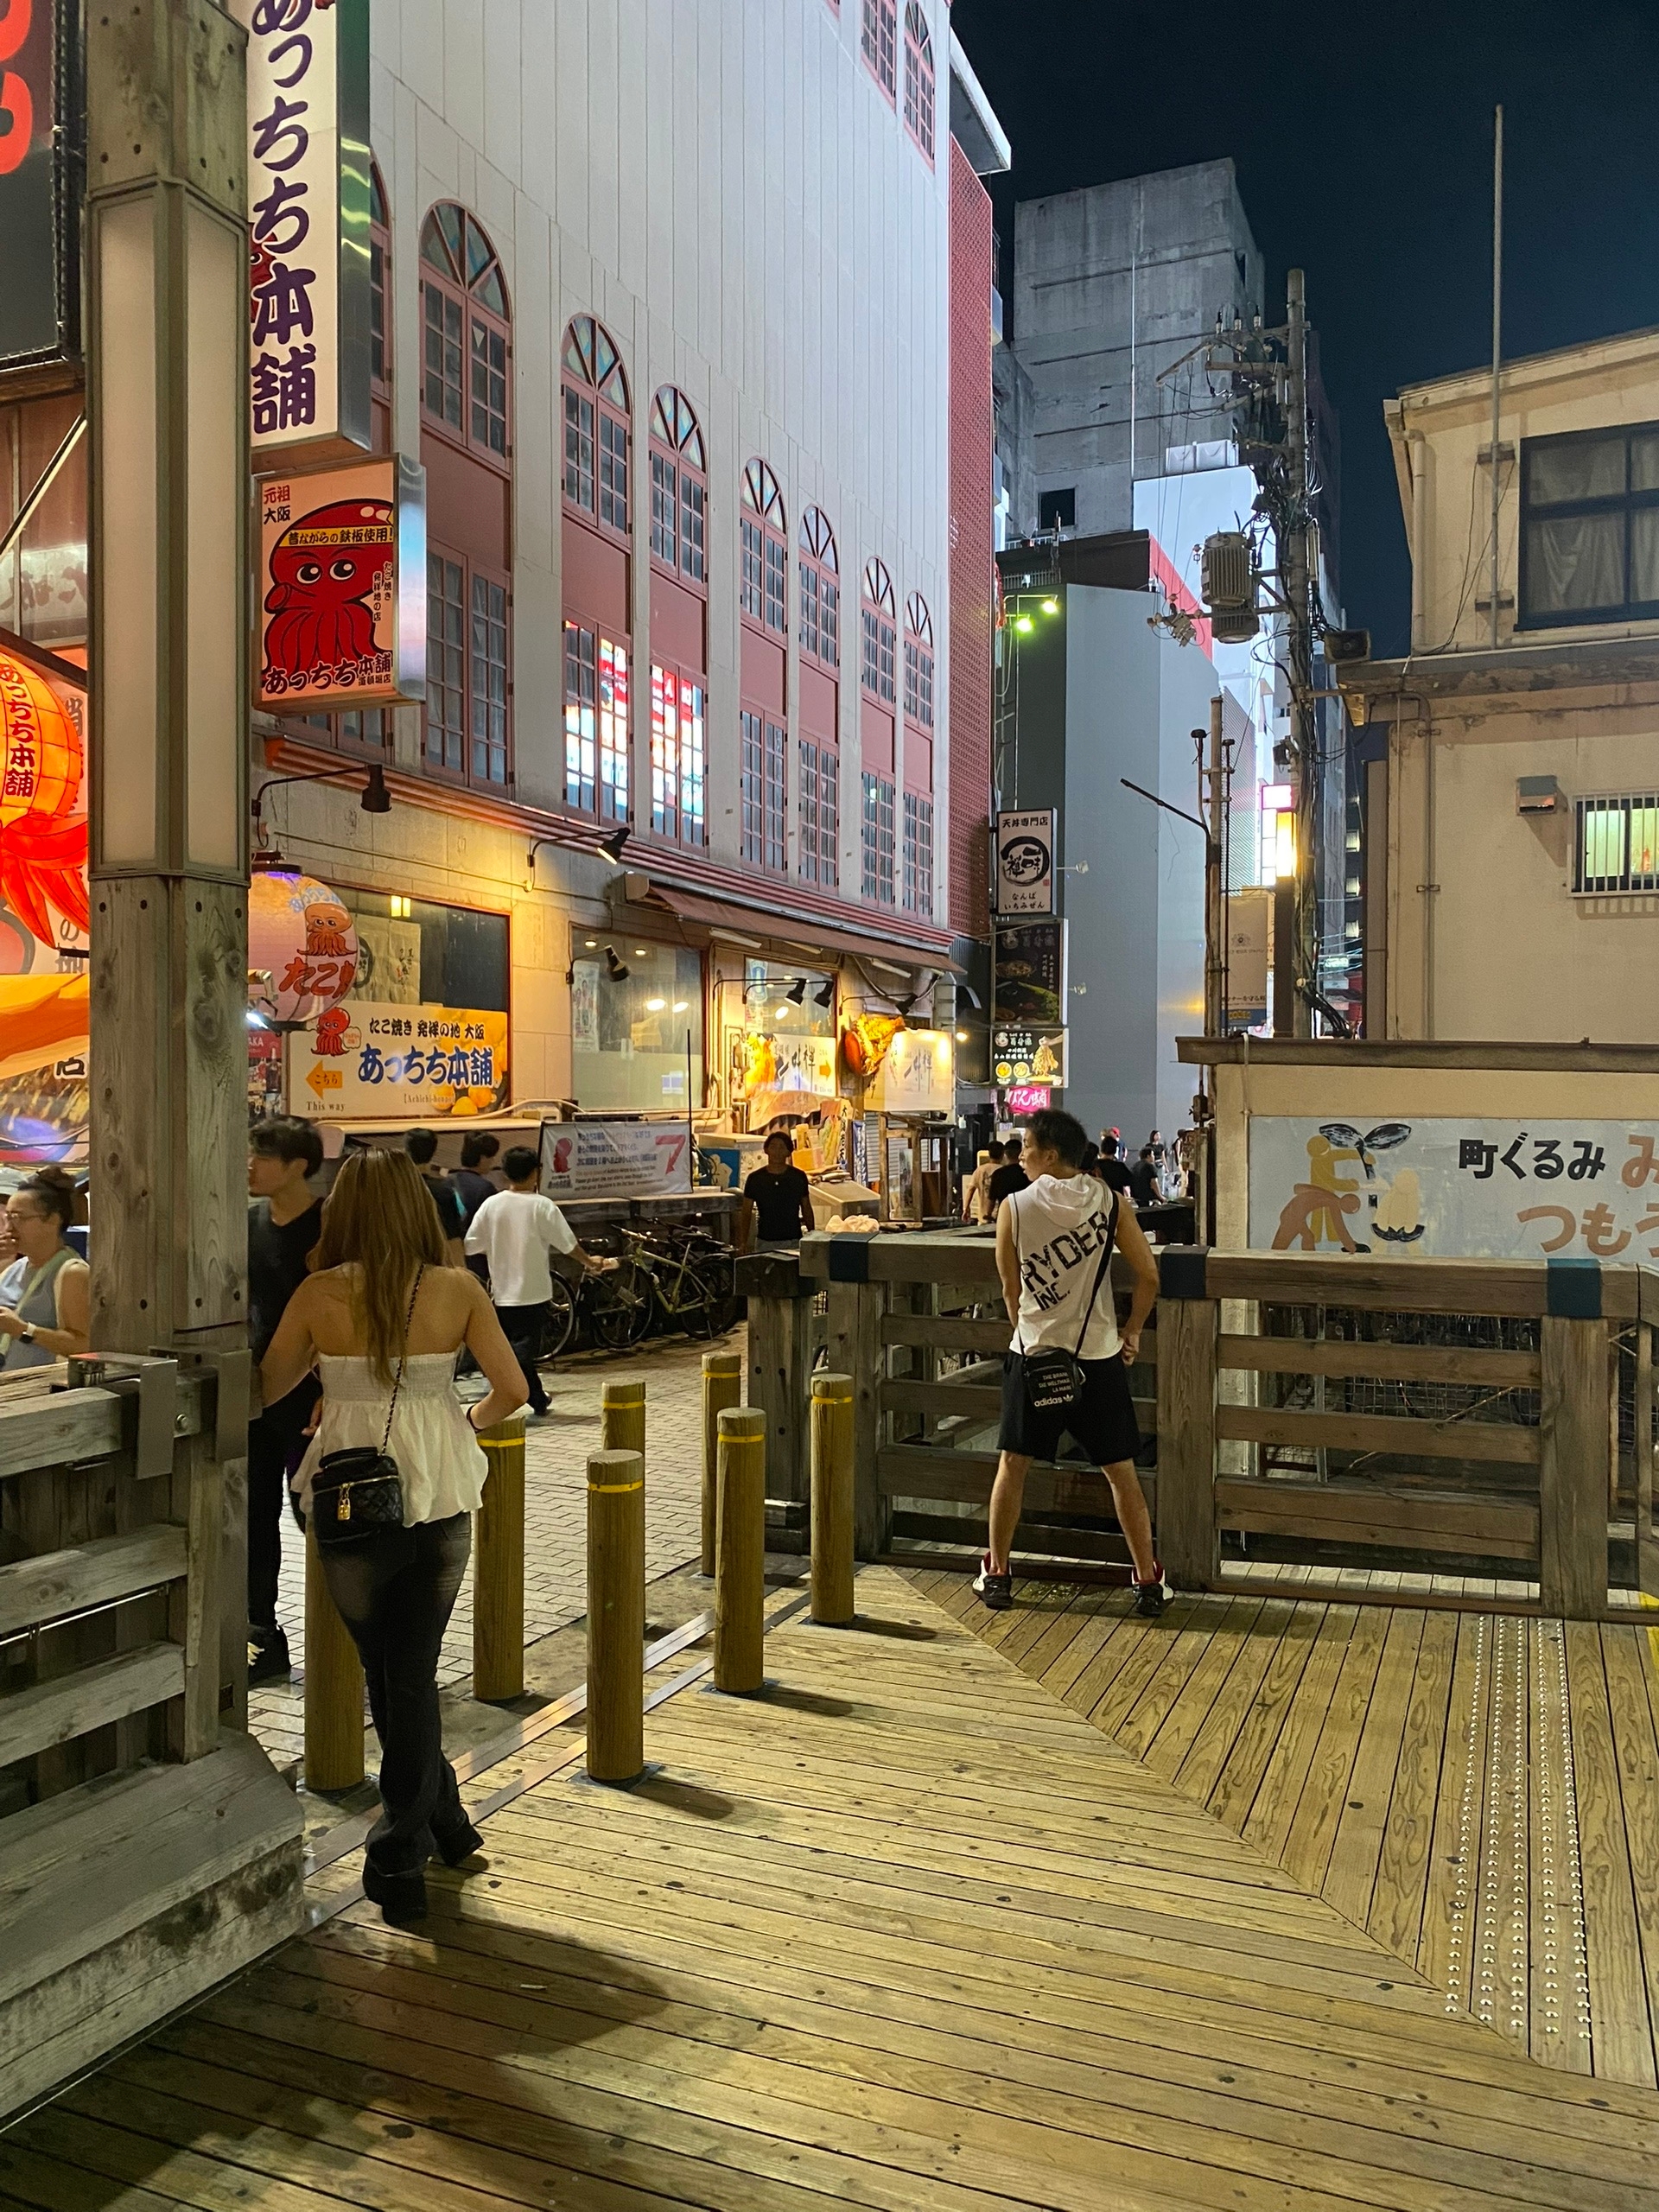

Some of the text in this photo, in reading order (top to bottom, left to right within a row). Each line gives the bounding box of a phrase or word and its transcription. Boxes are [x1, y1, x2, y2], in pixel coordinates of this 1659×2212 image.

[264, 485, 290, 504] 元祖
[264, 505, 290, 524] 大阪
[384, 562, 393, 601] たこ焼き
[265, 652, 391, 694] あっちち本舗
[0, 663, 35, 797] あっちち本舗
[1001, 817, 1048, 829] 天丼専門店
[1004, 901, 1045, 910] いちみぜん
[369, 1018, 485, 1040] たこ焼き 発祥の地 大阪
[359, 1043, 493, 1085] あっちち本舗
[315, 1074, 338, 1085] こちら
[307, 1102, 346, 1112] This way
[1458, 1132, 1605, 1180] 町ぐるみ
[1020, 1211, 1109, 1293] RYDER
[1033, 1396, 1063, 1407] adidas
